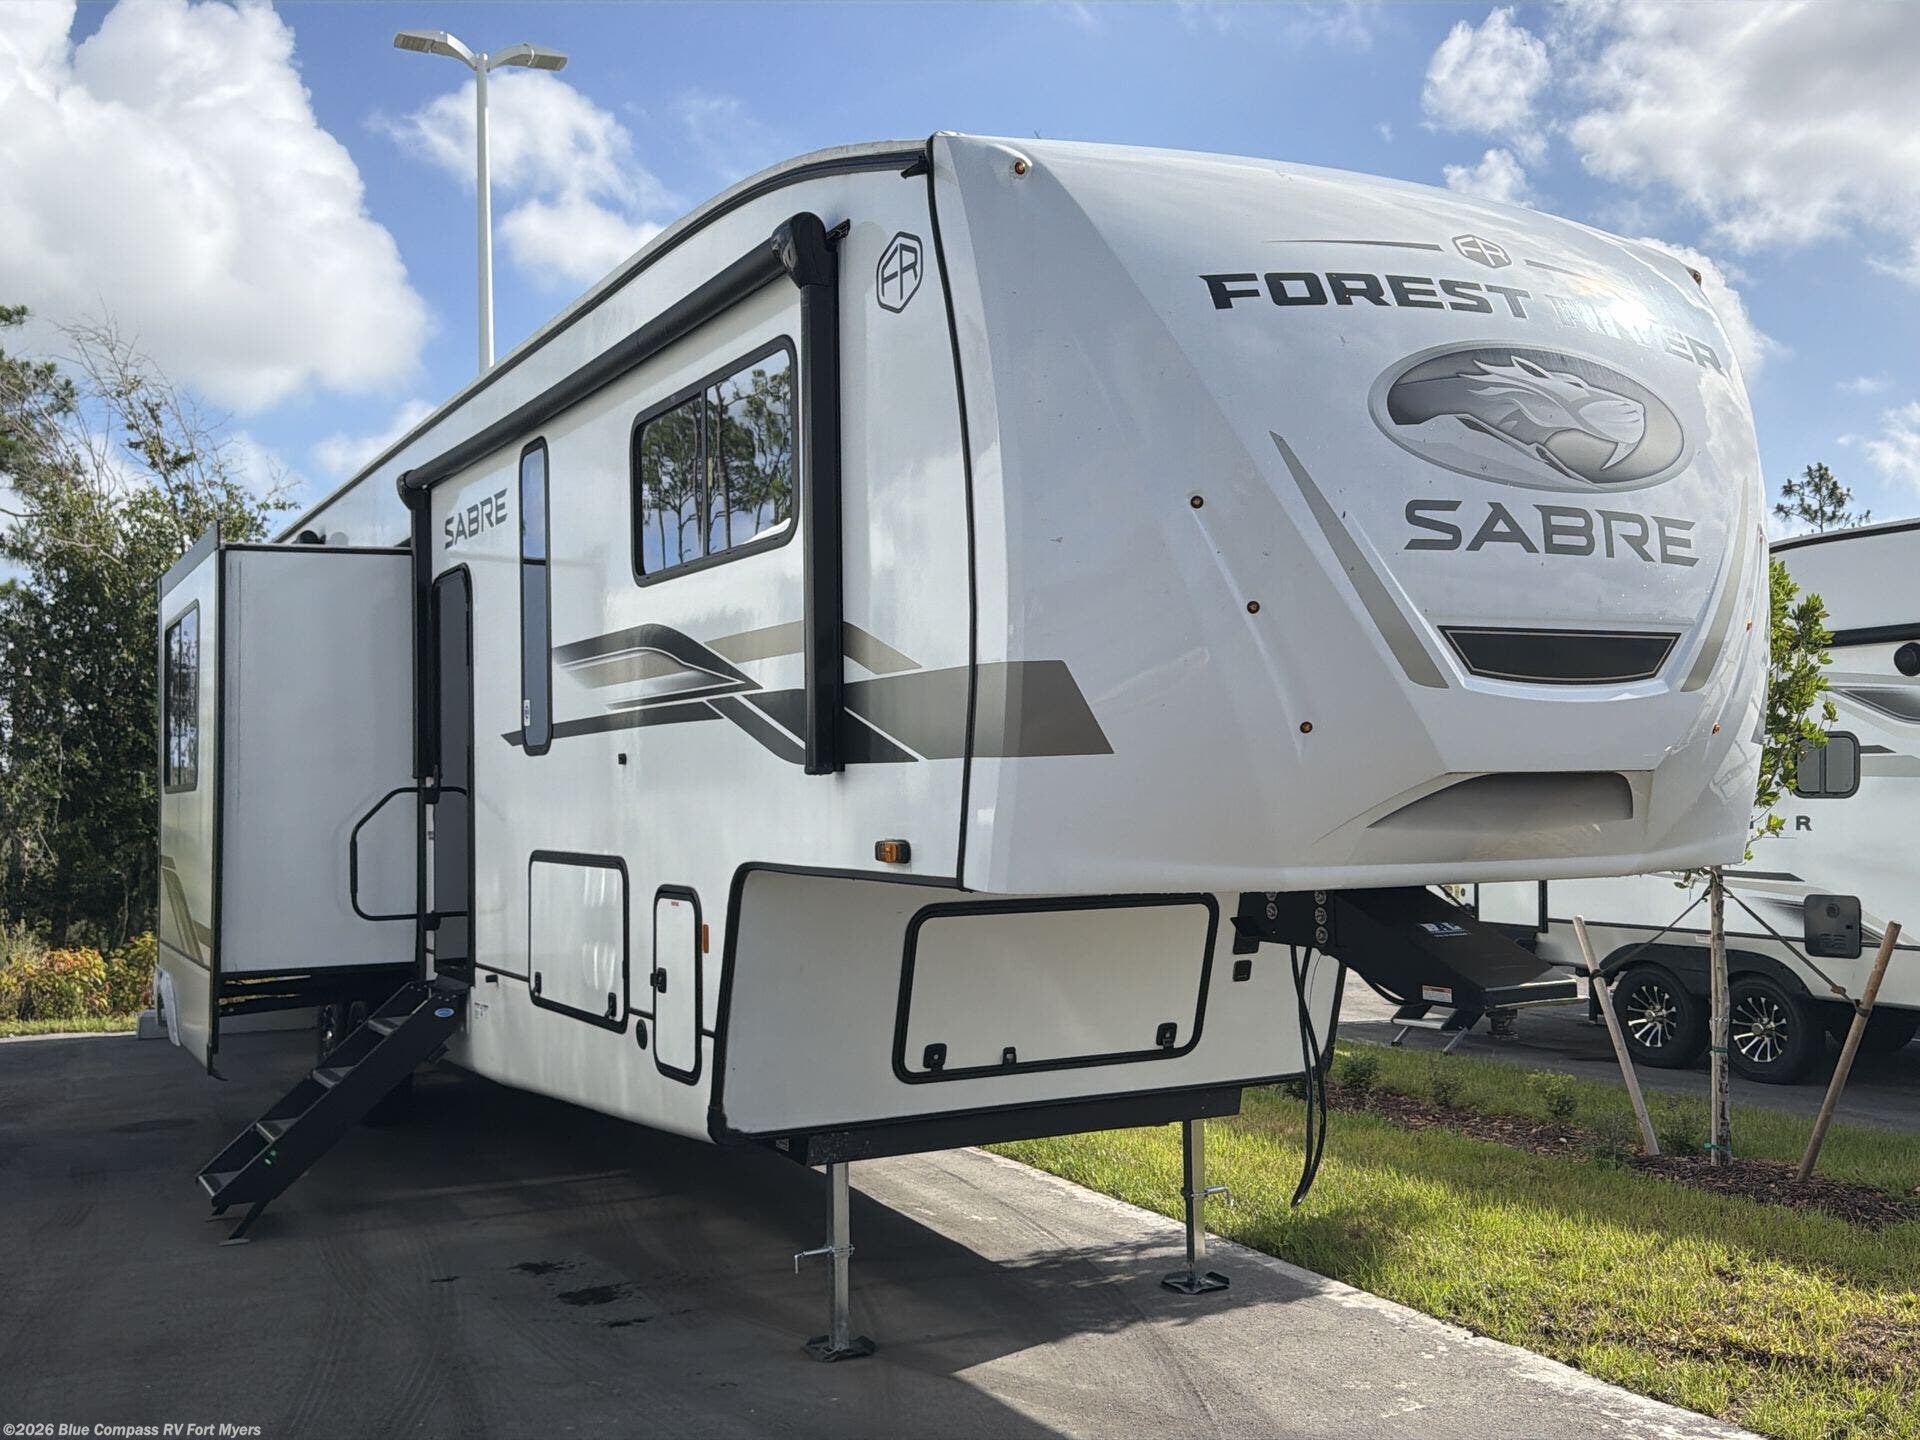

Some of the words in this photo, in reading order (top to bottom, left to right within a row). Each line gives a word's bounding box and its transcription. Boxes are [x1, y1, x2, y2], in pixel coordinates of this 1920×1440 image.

[1198, 272, 1531, 320] FOREST
[444, 488, 508, 550] SABRE
[1404, 499, 1700, 567] SABRE
